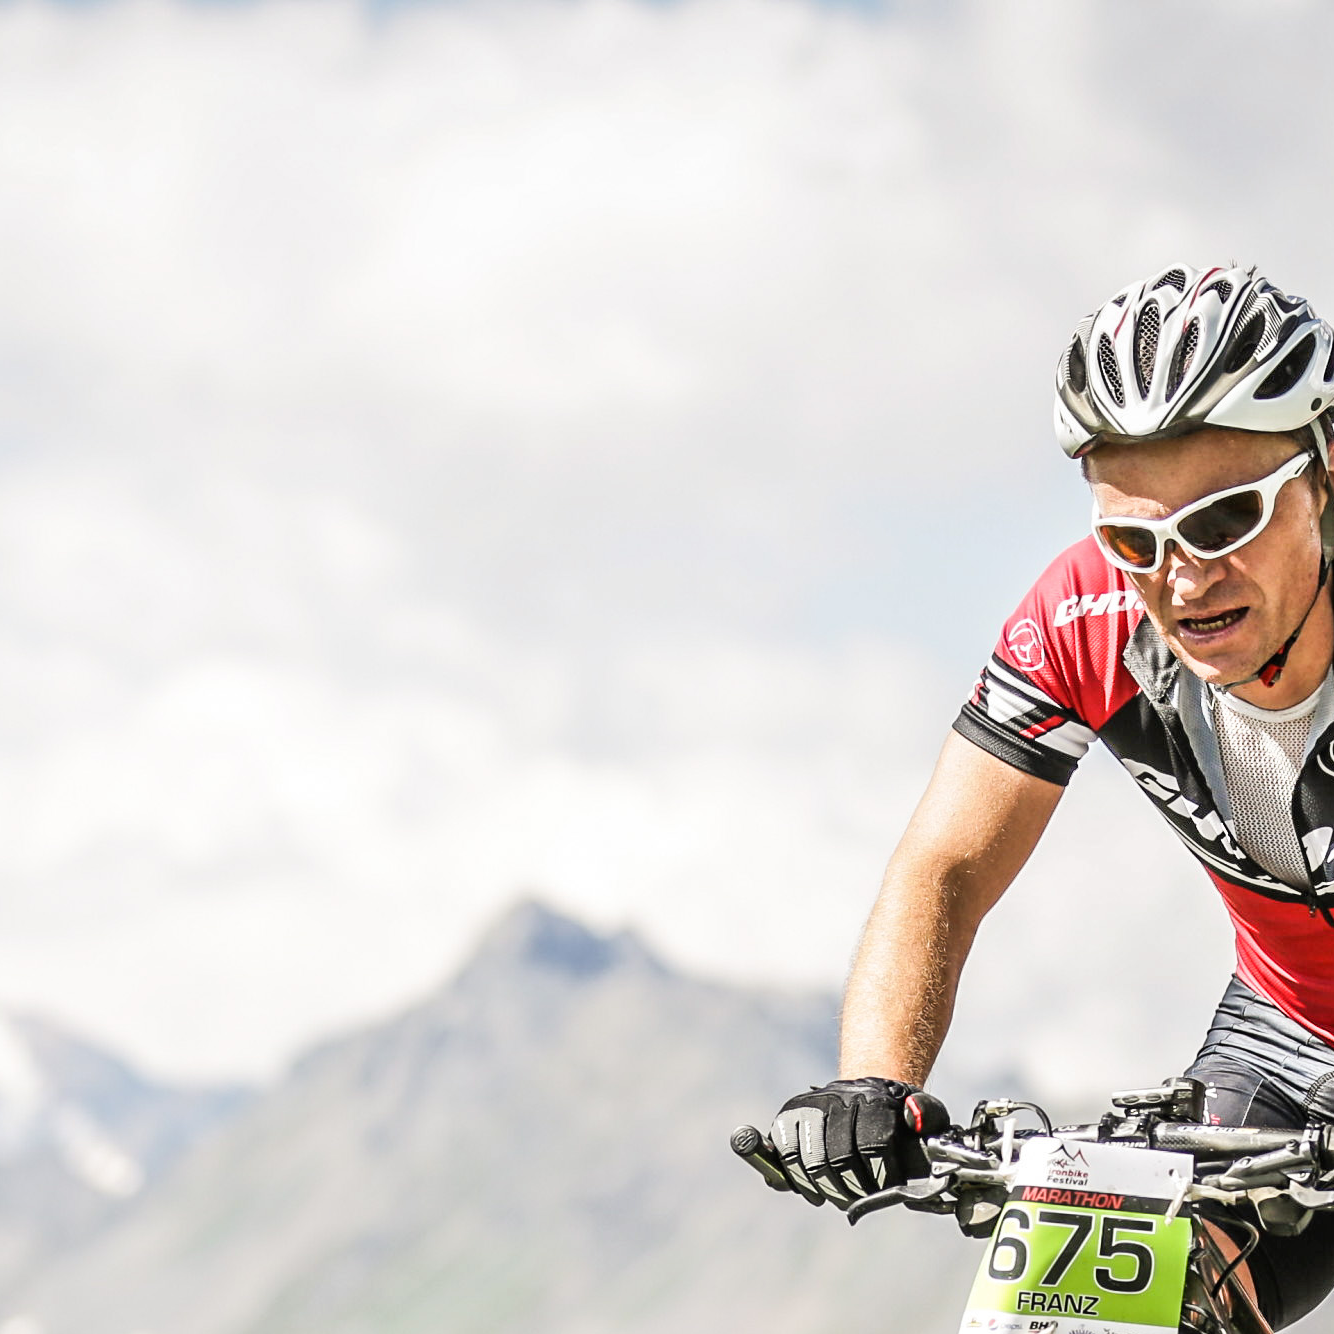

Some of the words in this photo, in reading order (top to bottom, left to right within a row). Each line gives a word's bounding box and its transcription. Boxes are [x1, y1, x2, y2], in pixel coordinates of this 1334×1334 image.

[1053, 589, 1144, 627] GHO
[1046, 1175, 1089, 1187] Festival
[1048, 1167, 1089, 1179] ironbike
[1022, 1185, 1125, 1210] MARATHON
[987, 1207, 1156, 1294] 675
[1017, 1291, 1099, 1316] FRANZ
